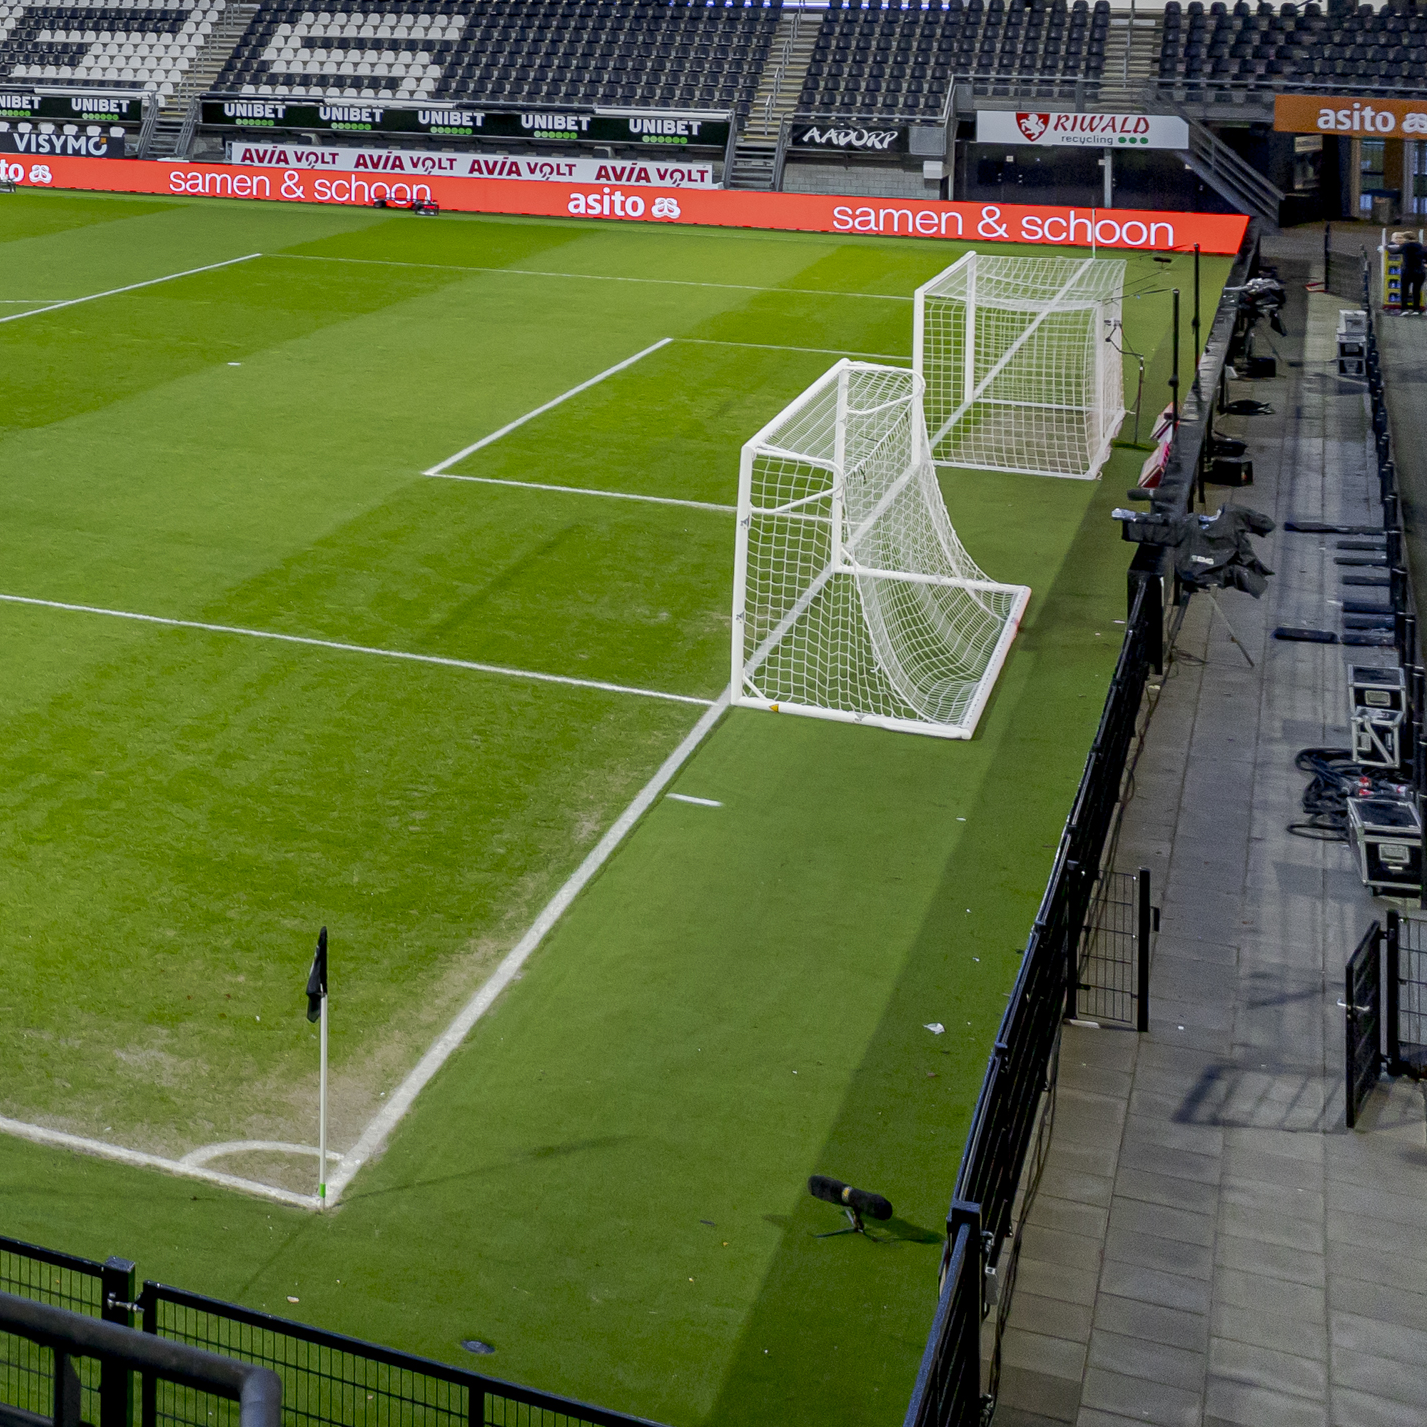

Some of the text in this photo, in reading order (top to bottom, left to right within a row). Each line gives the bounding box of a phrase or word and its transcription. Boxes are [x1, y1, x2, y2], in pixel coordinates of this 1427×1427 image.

[70, 97, 130, 113] UNIBET
[223, 103, 286, 119] UNIBET
[319, 106, 384, 123] UNIBET
[417, 109, 486, 127] UNIBET
[521, 113, 591, 131] UNIBET
[628, 118, 702, 136] UNIBET
[1053, 112, 1150, 135] RIWALD
[1316, 102, 1395, 133] asito
[13, 132, 108, 157] VISYMO
[802, 124, 899, 149] AADORP
[1061, 133, 1114, 147] recycling
[293, 150, 340, 169] VOLT
[409, 156, 458, 175] VOLT
[526, 161, 577, 181] VOLT
[655, 167, 709, 188] VOLT
[168, 169, 432, 206] samen & schoon
[567, 186, 646, 217] asito
[832, 205, 1175, 247] samen & schoon
